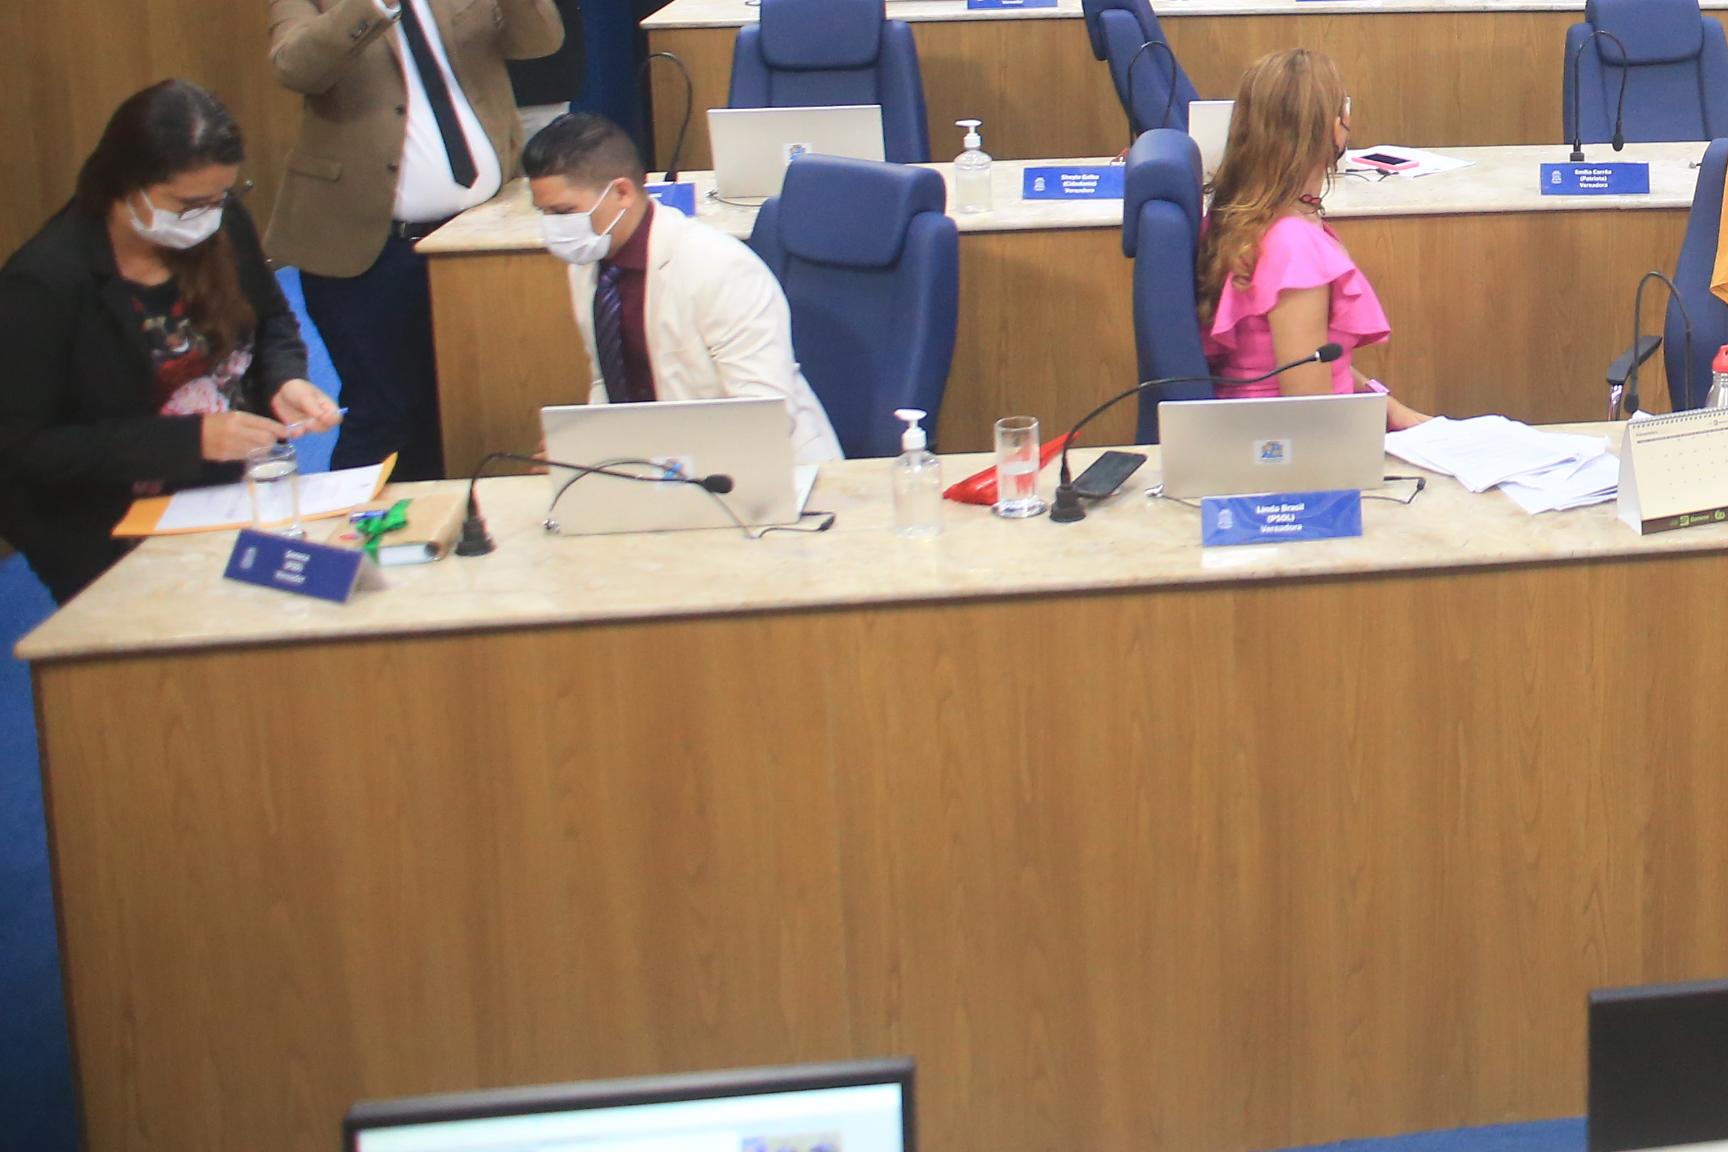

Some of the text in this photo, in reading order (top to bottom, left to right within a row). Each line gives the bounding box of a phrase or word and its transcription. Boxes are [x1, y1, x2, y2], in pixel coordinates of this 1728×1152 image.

[1256, 502, 1306, 515] Linda Brasil
[1267, 512, 1296, 524] (PSOL)
[1260, 523, 1304, 534] Vereadora
